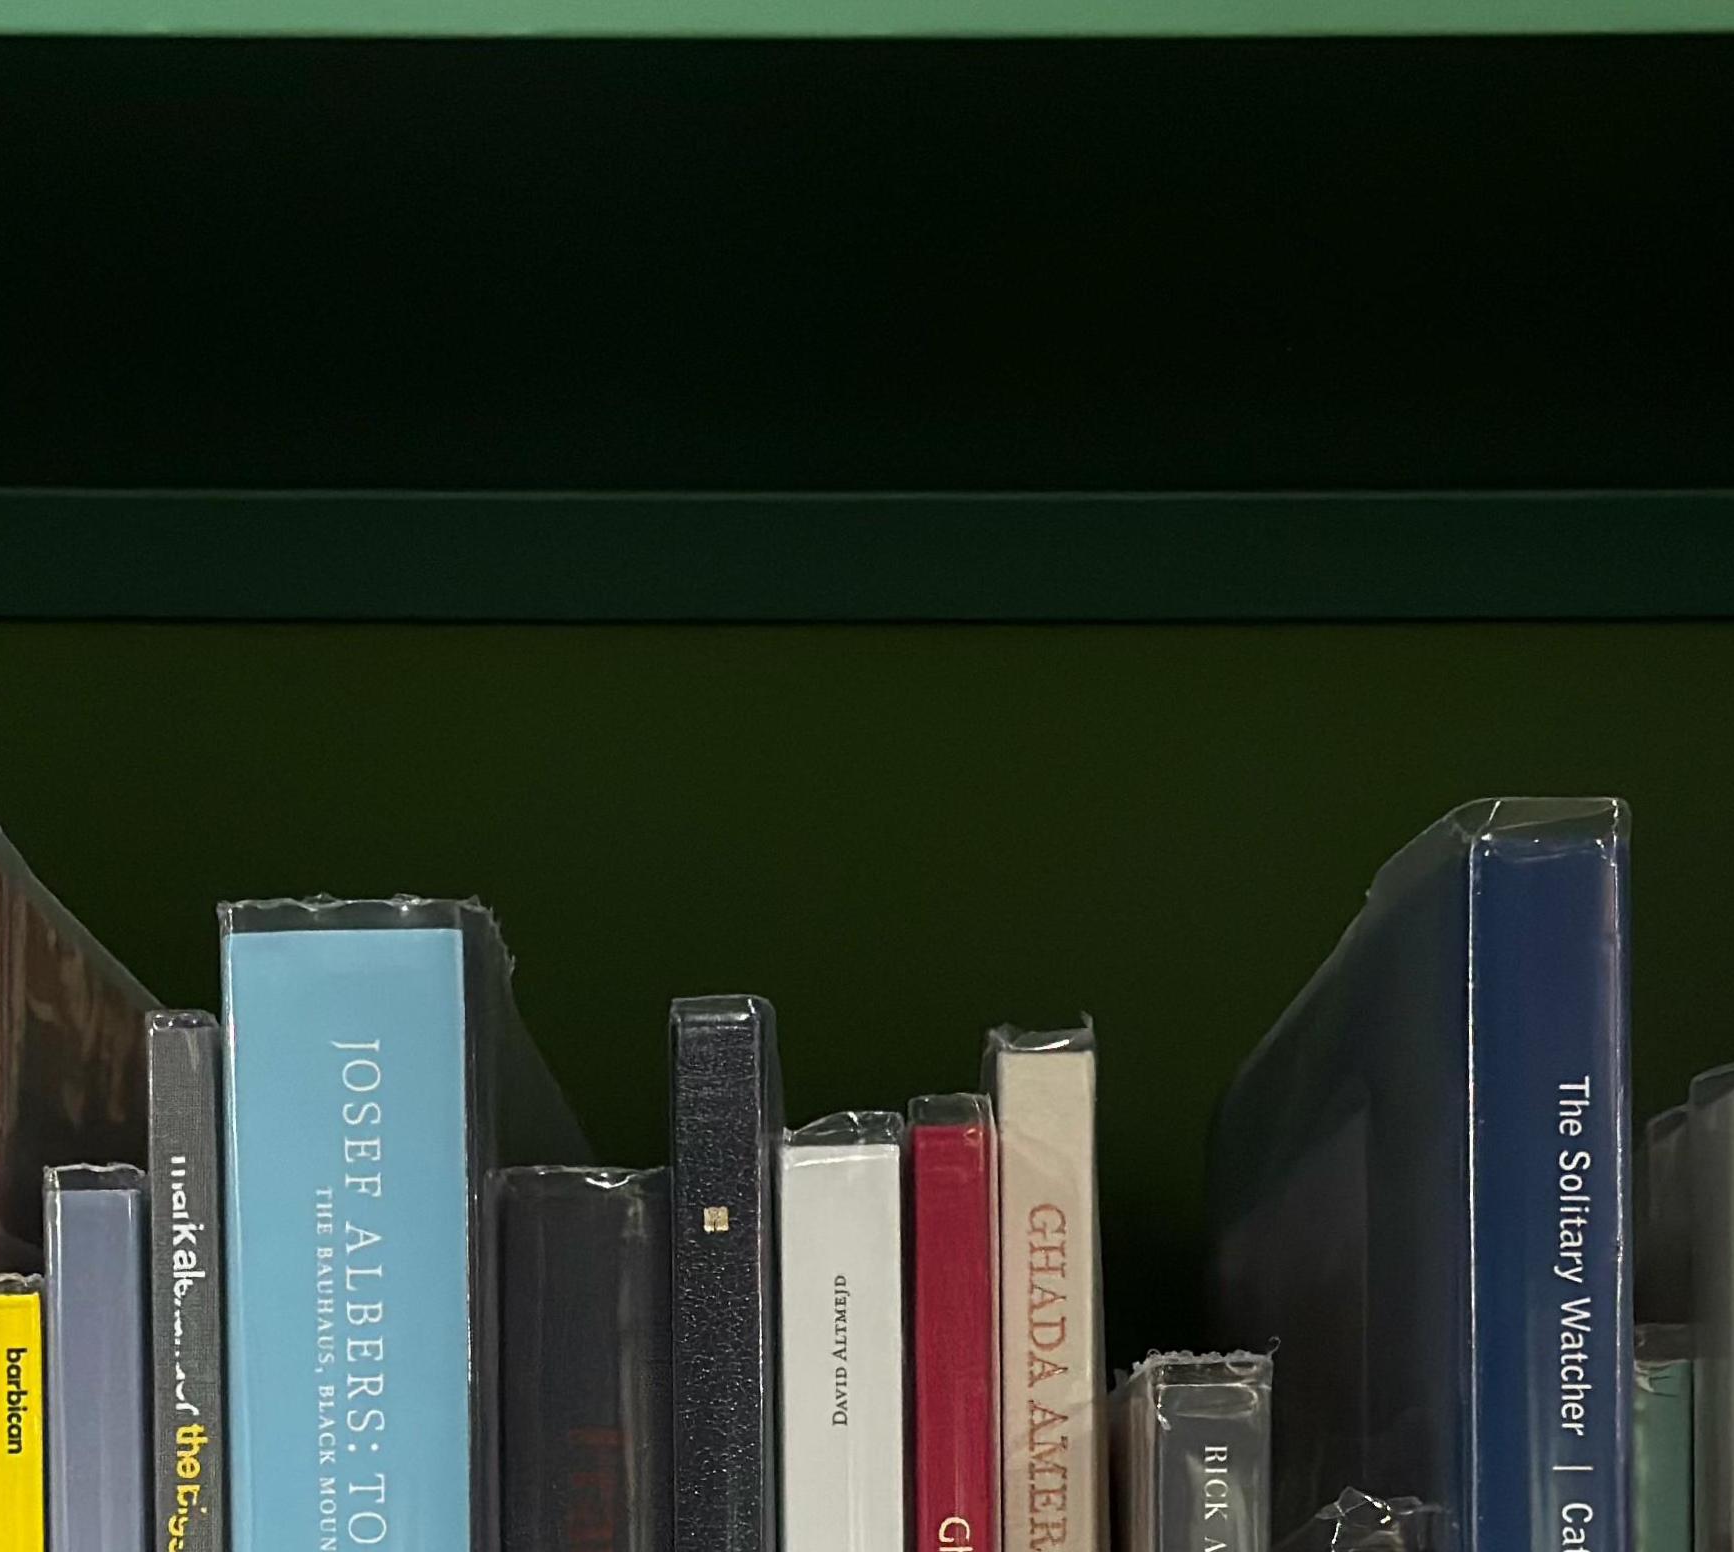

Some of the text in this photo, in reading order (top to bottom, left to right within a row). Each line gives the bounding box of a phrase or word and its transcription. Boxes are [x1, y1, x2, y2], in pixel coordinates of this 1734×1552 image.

[330, 1039, 382, 1198] JOSEF
[1558, 1075, 1590, 1137] The
[315, 1188, 333, 1234] THE
[1553, 1150, 1591, 1284] Solitary
[314, 1247, 335, 1373] BAUHAUS,
[344, 1220, 386, 1453] ALBERS:
[6, 1347, 28, 1456] barbican
[1560, 1297, 1592, 1436] Watcher
[318, 1385, 336, 1465] BLACK
[348, 1473, 388, 1544] TO
[1204, 1446, 1229, 1520] RICK
